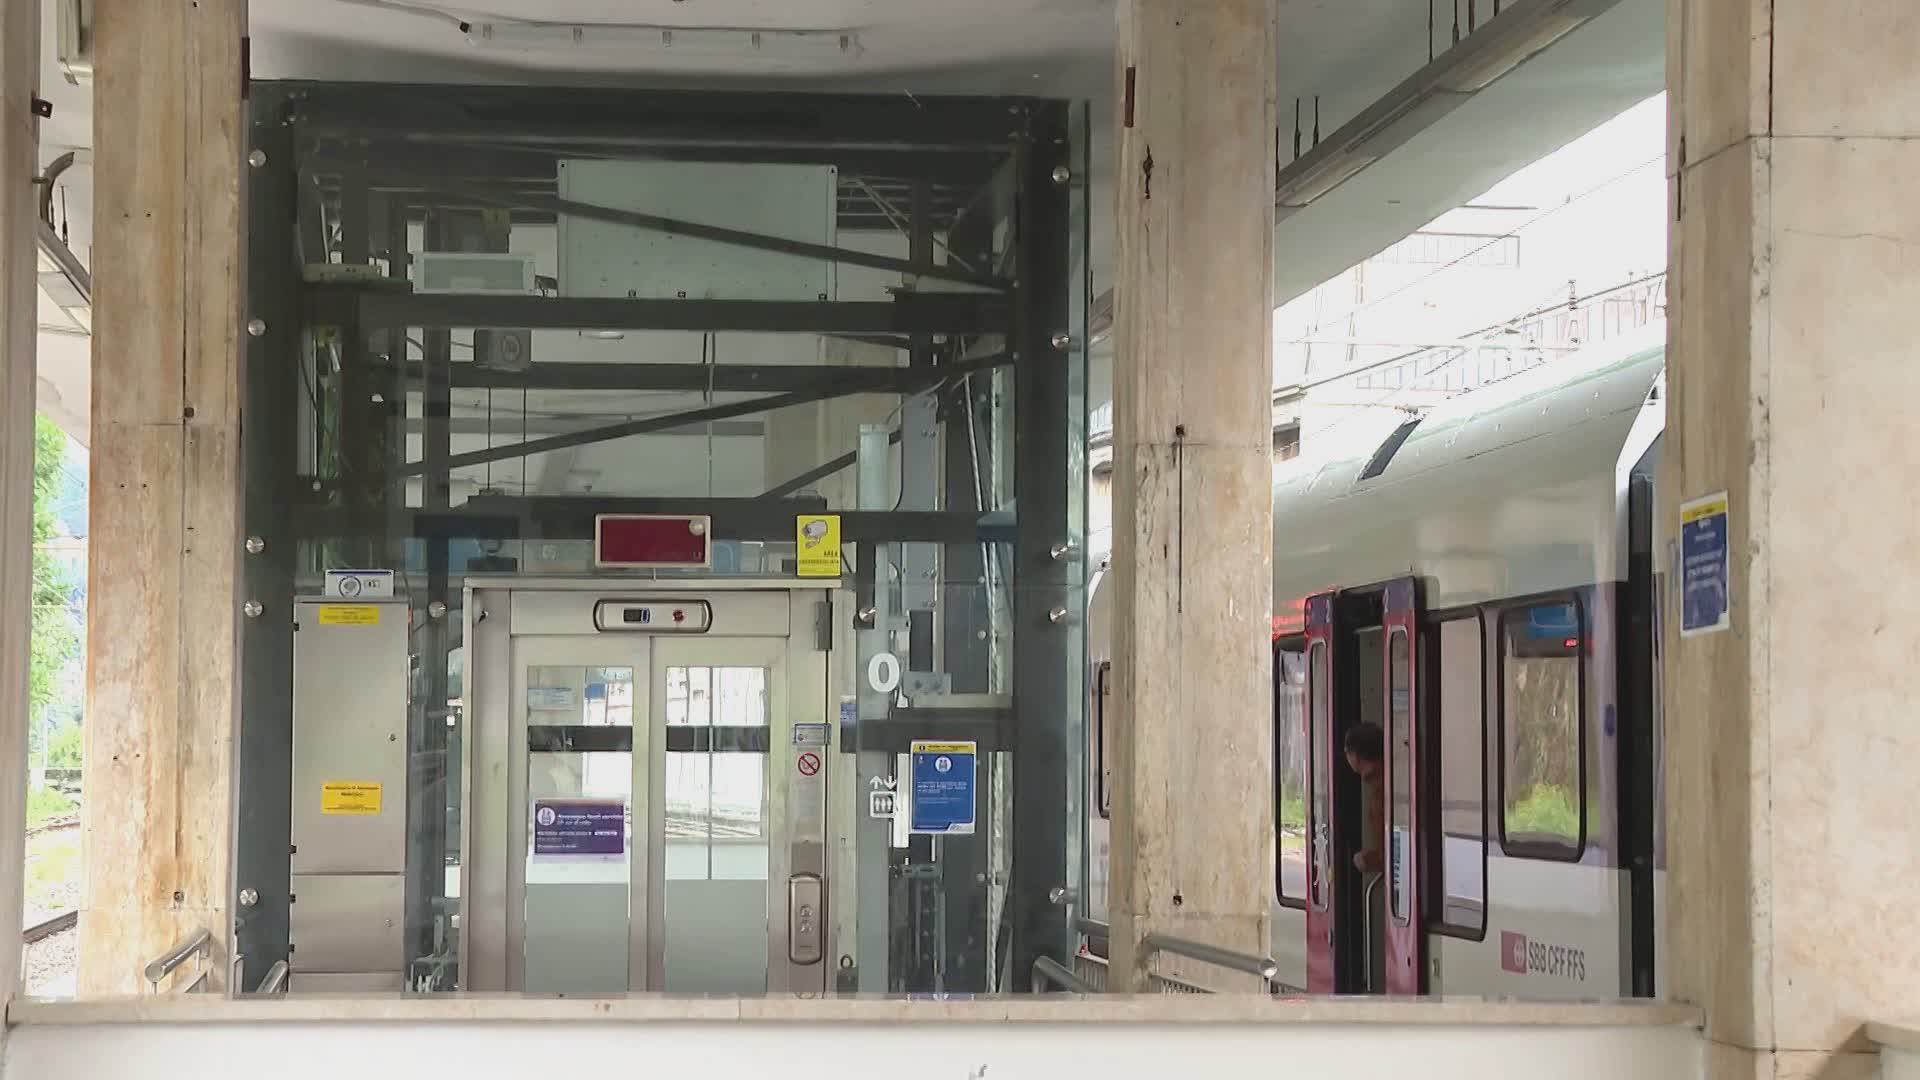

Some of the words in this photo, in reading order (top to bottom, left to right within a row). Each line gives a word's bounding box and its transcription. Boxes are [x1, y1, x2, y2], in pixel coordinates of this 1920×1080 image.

[1528, 941, 1546, 973] SBB
[1548, 945, 1565, 976] CFF
[1567, 948, 1585, 982] FFS
